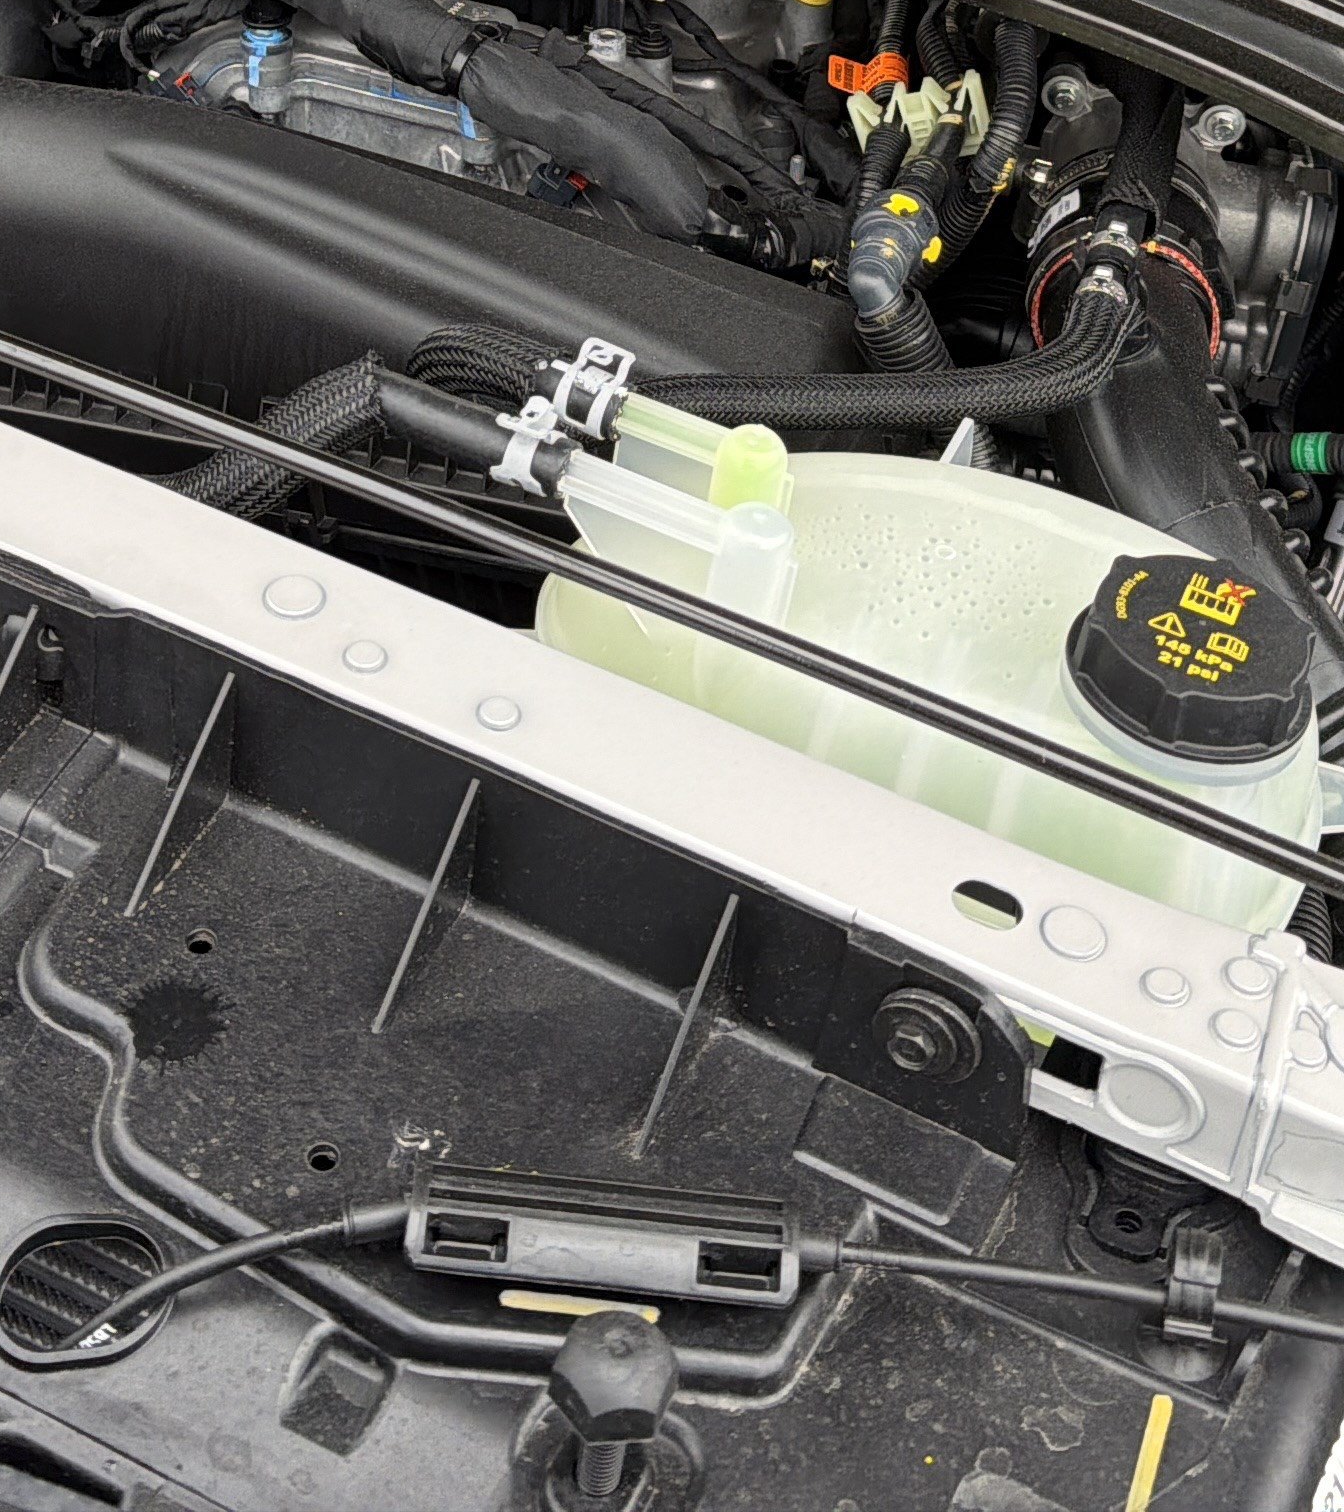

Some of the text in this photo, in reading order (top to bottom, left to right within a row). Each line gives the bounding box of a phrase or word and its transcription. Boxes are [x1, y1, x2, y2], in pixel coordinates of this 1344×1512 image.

[1157, 650, 1220, 683] 21 psi
[1194, 648, 1233, 673] kPa
